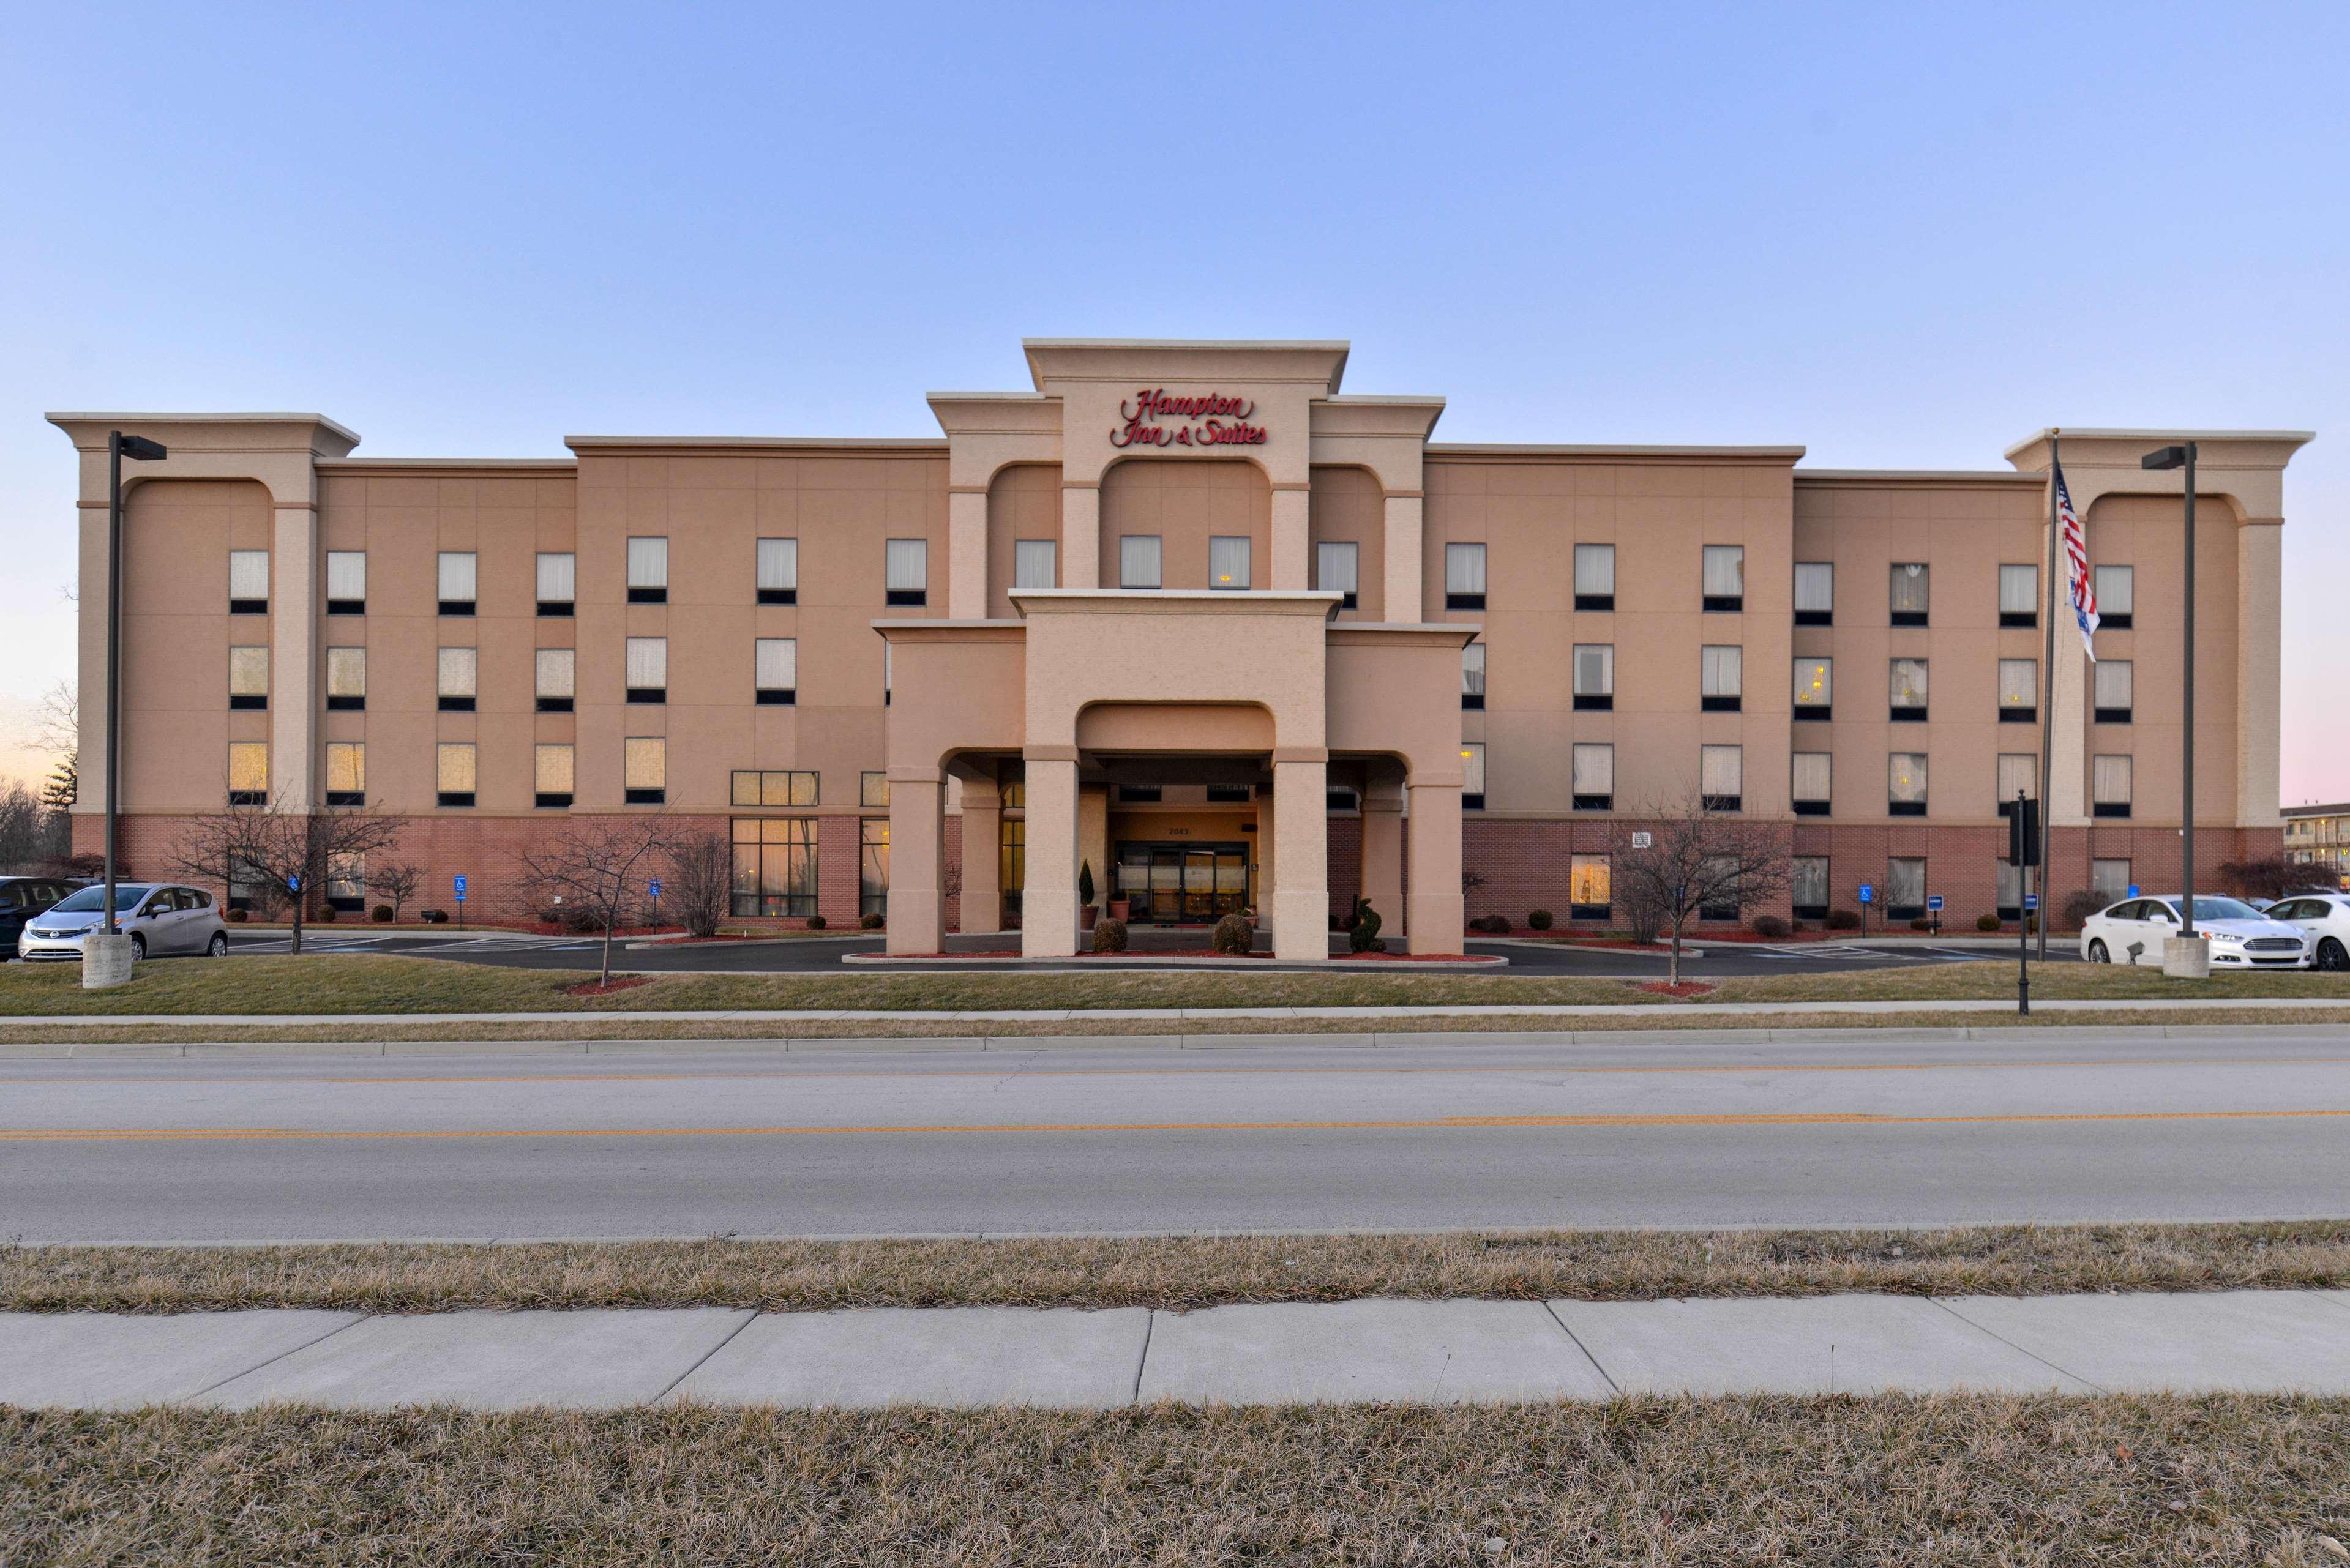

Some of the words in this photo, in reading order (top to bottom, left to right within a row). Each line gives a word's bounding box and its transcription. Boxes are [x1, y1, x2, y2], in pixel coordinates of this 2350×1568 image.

[1121, 388, 1254, 421] Hampton
[1110, 420, 1173, 447] Inn
[1176, 425, 1193, 446] &
[1195, 419, 1267, 445] Suites
